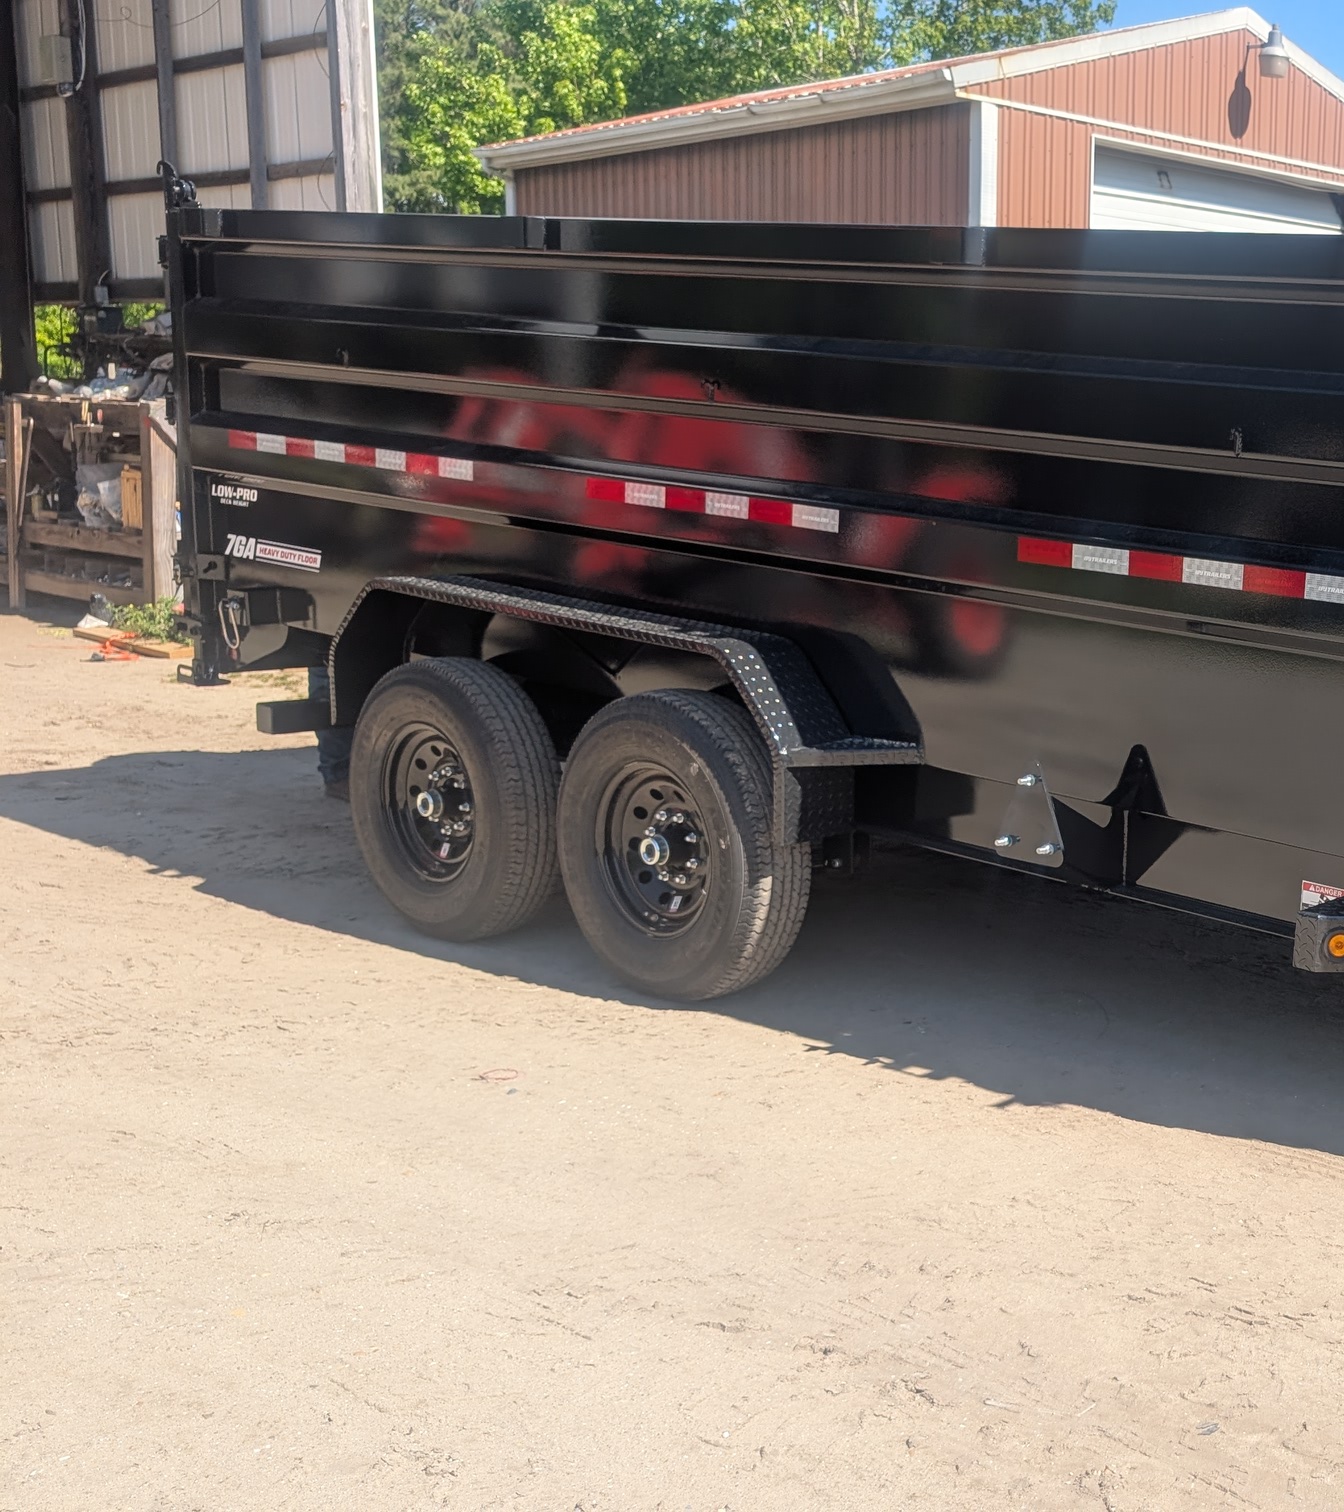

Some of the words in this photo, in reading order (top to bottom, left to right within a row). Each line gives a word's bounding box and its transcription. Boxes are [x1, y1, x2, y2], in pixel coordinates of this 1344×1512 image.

[224, 533, 256, 560] 7GA
[258, 546, 280, 557] HEAVY
[280, 550, 297, 561] DUTY
[297, 554, 318, 565] FLOOR
[1315, 886, 1343, 897] DANGER
